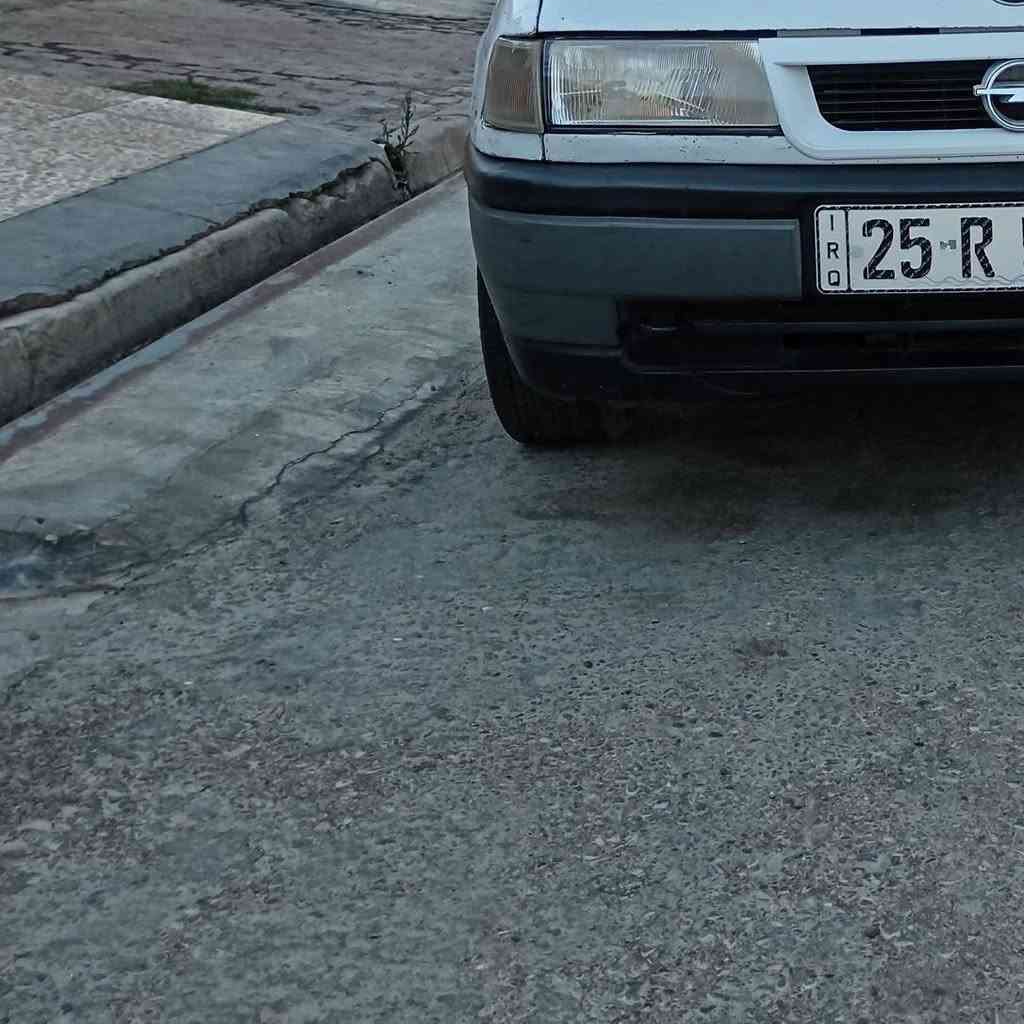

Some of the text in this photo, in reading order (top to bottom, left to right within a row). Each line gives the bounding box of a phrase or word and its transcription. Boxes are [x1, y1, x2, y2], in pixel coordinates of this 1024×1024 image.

[827, 214, 840, 287] IRQ
[862, 218, 932, 280] 25
[961, 216, 996, 279] R
